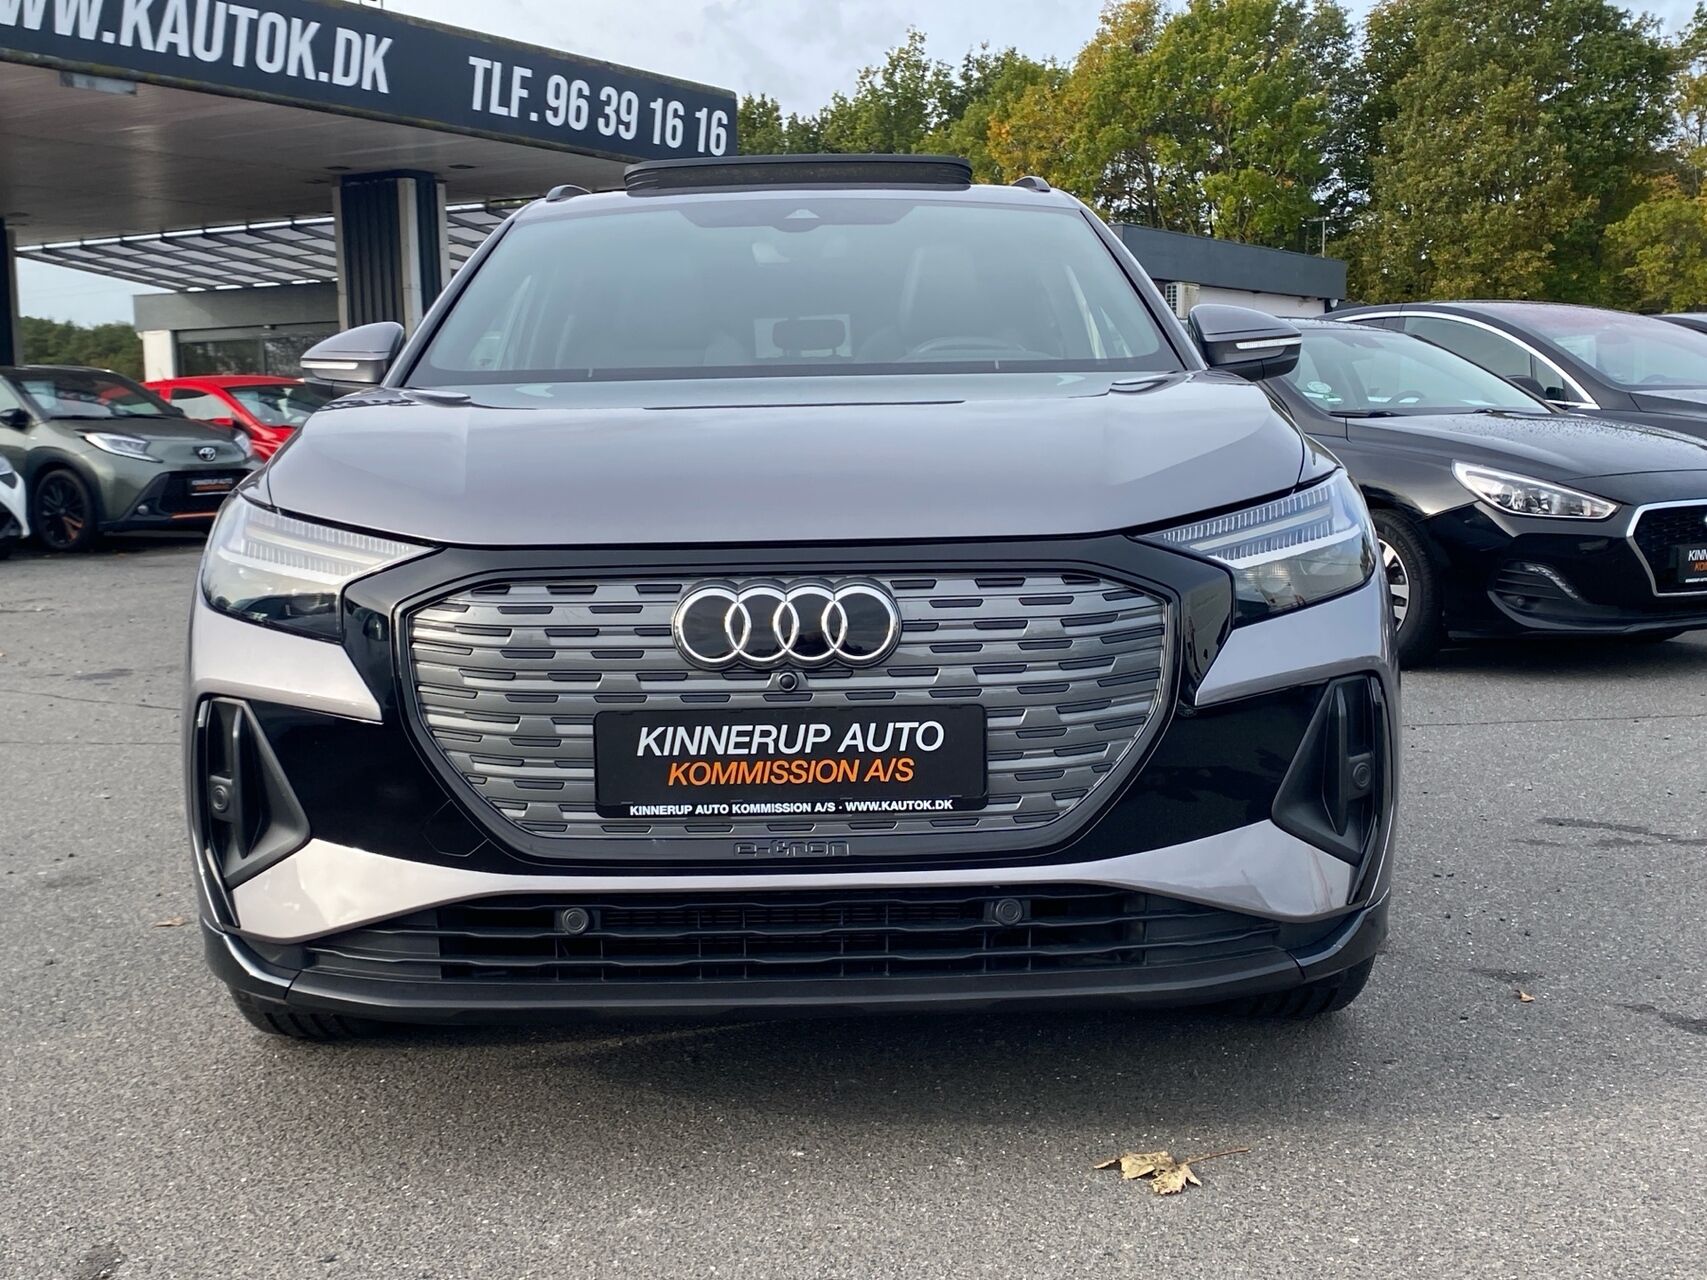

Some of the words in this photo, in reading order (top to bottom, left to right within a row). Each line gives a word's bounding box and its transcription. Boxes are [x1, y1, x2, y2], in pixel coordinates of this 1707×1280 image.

[468, 56, 539, 122] TLF.
[545, 74, 590, 131] 96
[598, 86, 639, 140] 39
[650, 97, 685, 149] 16
[695, 107, 728, 156] 16
[637, 723, 831, 757] KINNERUP
[838, 721, 944, 753] AUTO
[668, 758, 859, 787] KOMMISSION
[864, 757, 915, 783] A/S
[630, 804, 692, 816] KINNERUP
[695, 803, 729, 815] AUTO
[732, 802, 812, 815] KOMMISSION
[815, 802, 836, 813] A/S
[845, 799, 953, 813] WWW.KAUTOK.DK
